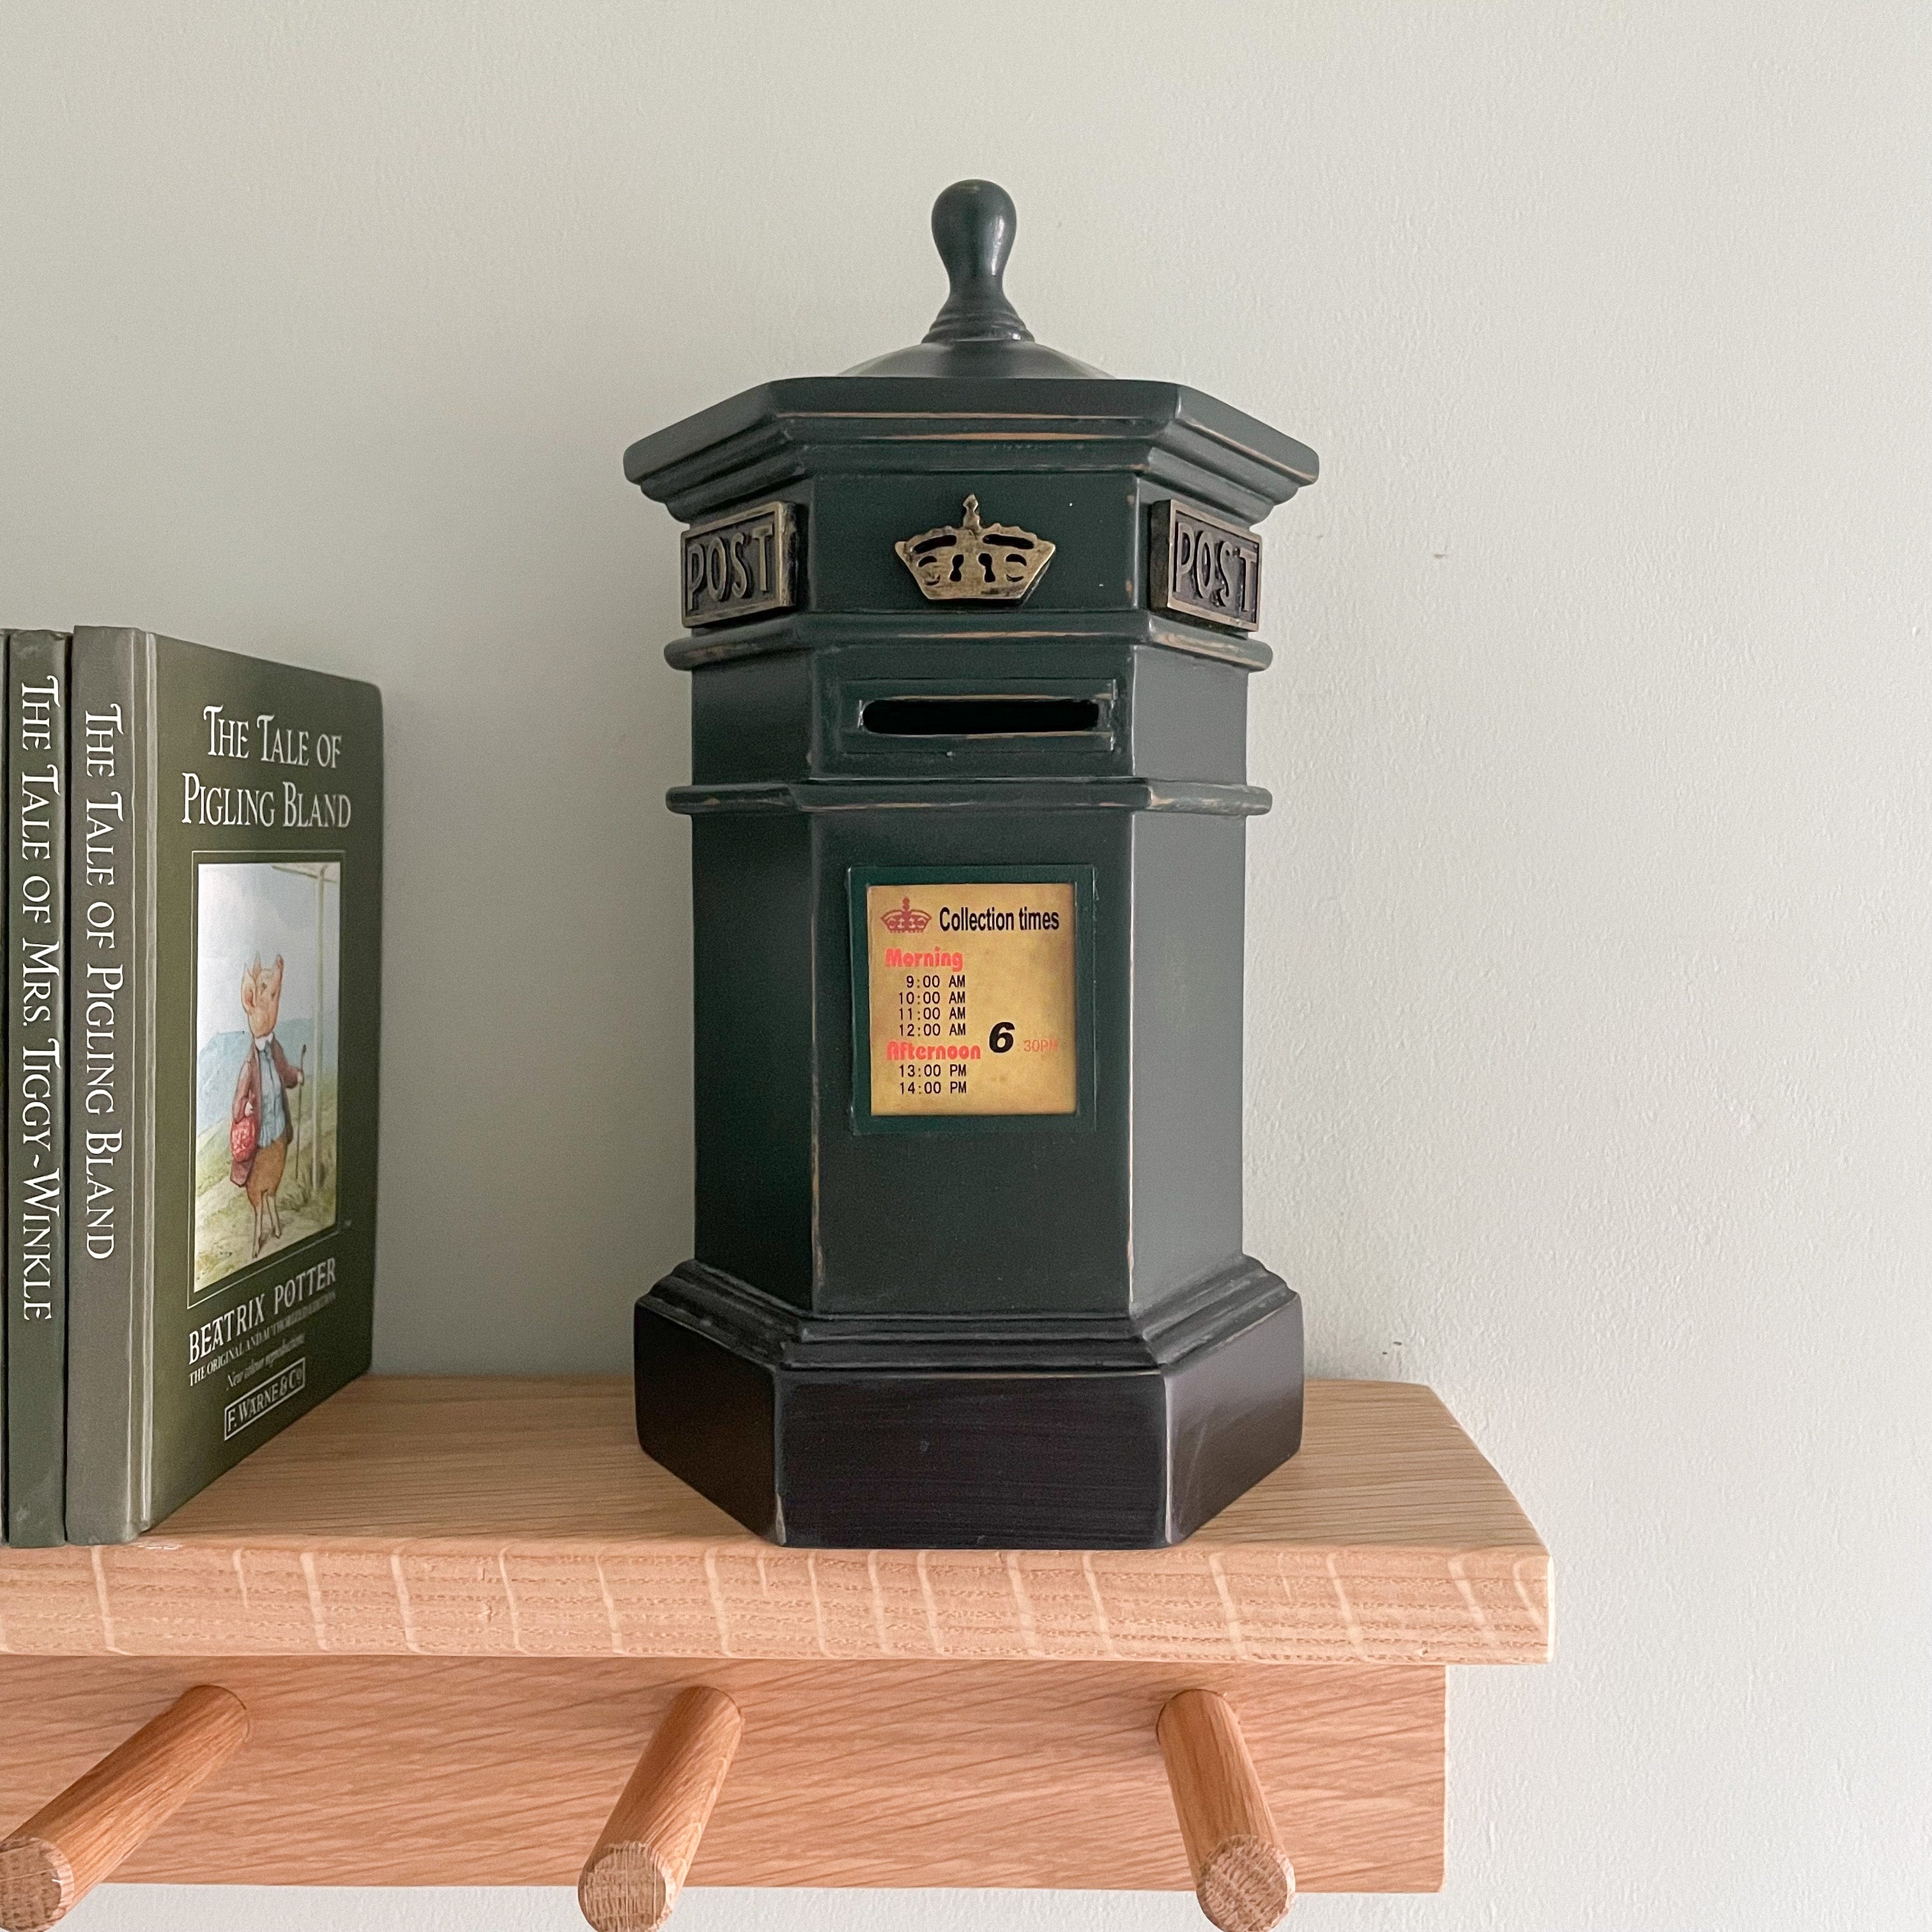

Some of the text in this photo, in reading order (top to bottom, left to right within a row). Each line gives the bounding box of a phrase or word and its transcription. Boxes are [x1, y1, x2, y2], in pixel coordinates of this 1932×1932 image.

[687, 523, 774, 611] POST
[1176, 521, 1257, 612] POST
[22, 675, 61, 751] THE
[203, 705, 342, 769] THE TALE OF
[22, 763, 61, 861] TALE
[181, 772, 351, 828] PIGLING BLAND
[22, 875, 52, 924] OF
[939, 906, 1060, 931] Collection times
[22, 937, 60, 1027] MRS.
[85, 703, 125, 1260] THE TALE OF PIGLING BLAND
[884, 946, 963, 972] Morning
[906, 975, 966, 988] 9:00 AM
[898, 992, 966, 1004] 10:00 AM
[898, 1007, 966, 1020] 11:00 AM
[885, 1040, 981, 1061] Afternoon
[899, 1023, 966, 1037] 12:00 AM
[899, 1064, 967, 1078] 13:00 PM
[900, 1081, 967, 1094] 14:00 PM
[189, 1293, 265, 1365] BEATRIX
[273, 1257, 336, 1315] POTTER
[189, 1365, 206, 1386] THE
[206, 1342, 243, 1375] ORIGINAL
